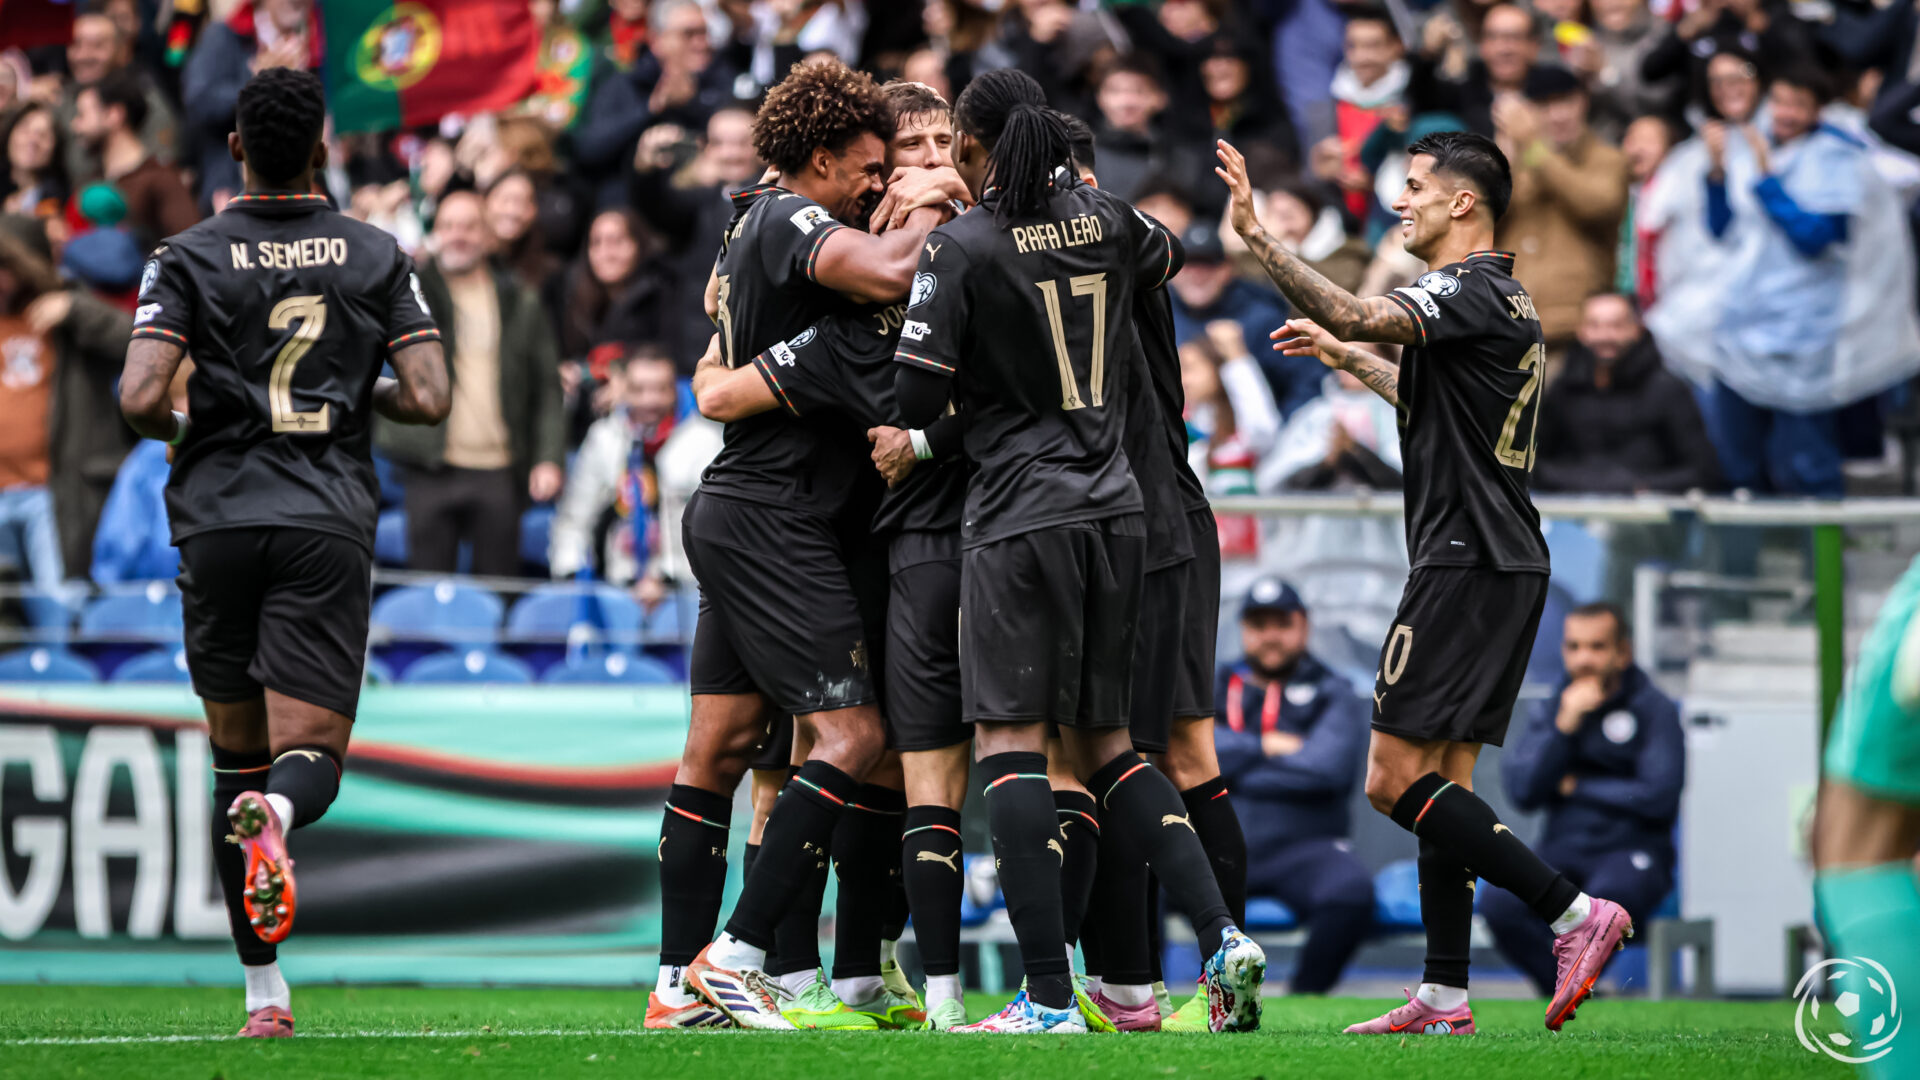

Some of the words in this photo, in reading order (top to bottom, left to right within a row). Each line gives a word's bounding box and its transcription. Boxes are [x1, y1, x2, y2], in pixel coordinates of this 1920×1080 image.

[230, 242, 256, 270] N.
[257, 237, 348, 270] SEMEDO
[1012, 223, 1061, 254] RAFA
[1060, 213, 1103, 247] LEÃO
[267, 295, 331, 434] 2
[1034, 272, 1107, 411] 17
